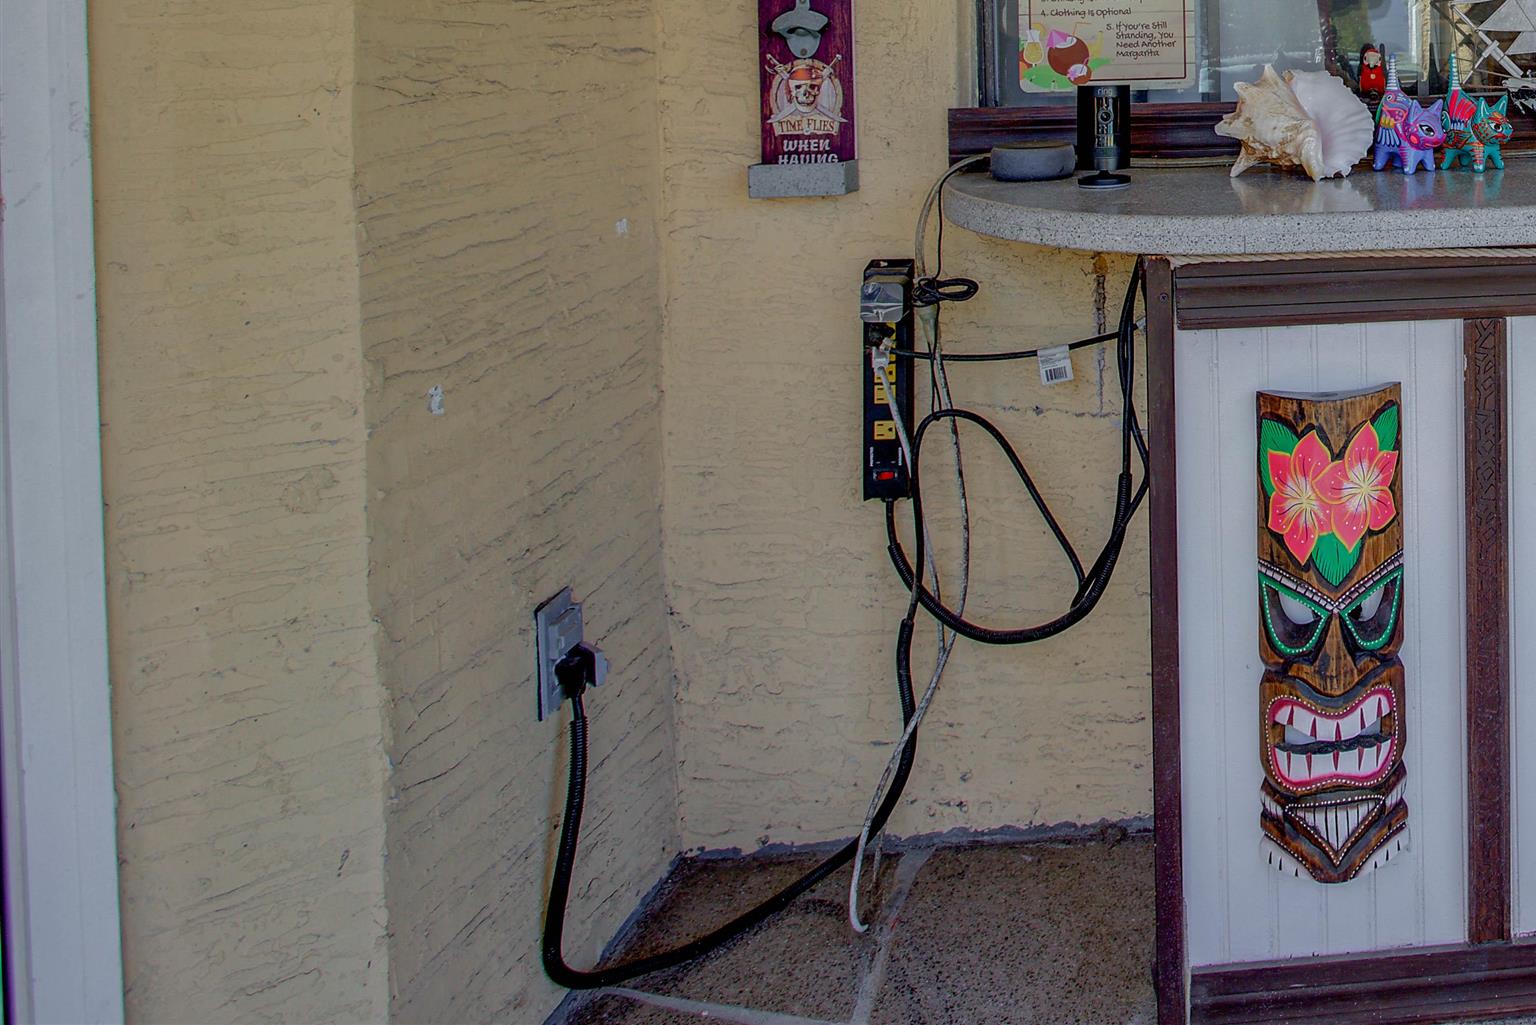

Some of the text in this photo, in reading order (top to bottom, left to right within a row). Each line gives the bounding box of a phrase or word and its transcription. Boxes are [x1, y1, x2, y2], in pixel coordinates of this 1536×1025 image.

[1050, 8, 1086, 18] Clothing
[1096, 8, 1132, 18] Optional
[1116, 21, 1122, 32] If
[1122, 22, 1150, 31] You're
[1152, 21, 1168, 29] Still
[1116, 31, 1157, 41] Standing,
[1116, 40, 1177, 49] Need Another
[1116, 49, 1160, 60] Margarita
[1097, 87, 1113, 97] ring
[778, 118, 835, 133] TIME FLIES
[783, 139, 831, 152] WHEN
[778, 153, 839, 164] HAVING
